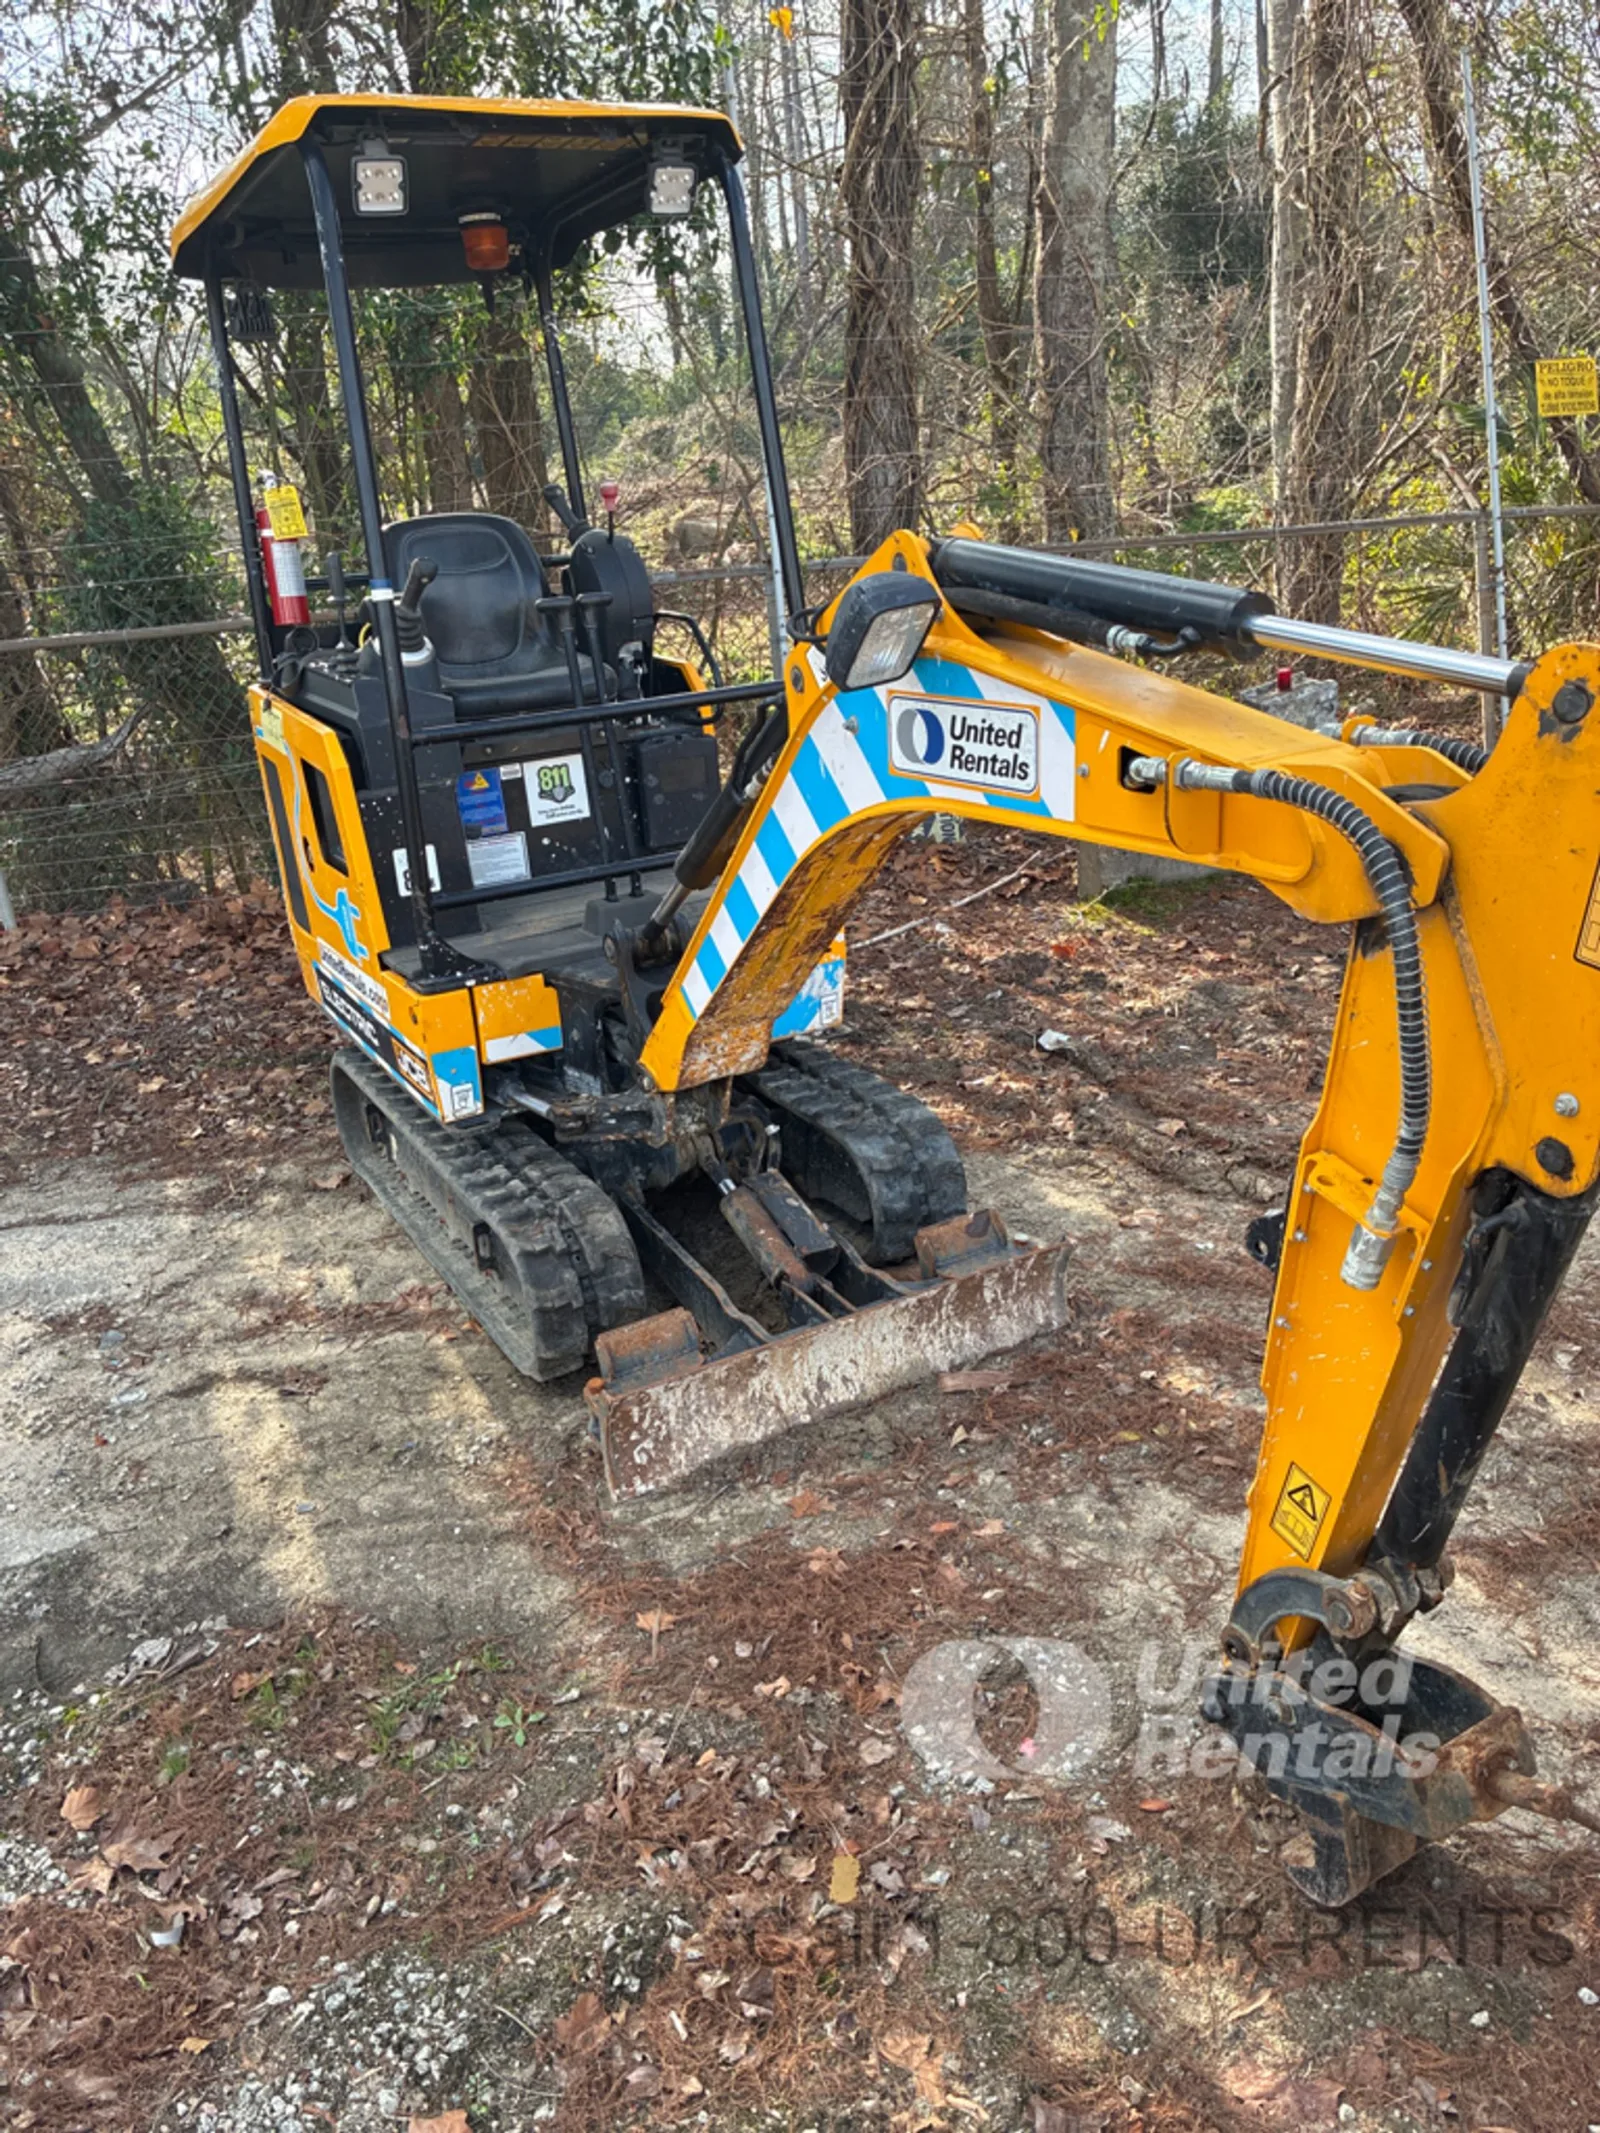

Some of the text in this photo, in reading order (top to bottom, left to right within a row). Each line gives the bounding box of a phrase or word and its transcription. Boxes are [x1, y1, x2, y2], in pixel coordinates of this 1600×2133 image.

[1540, 360, 1593, 374] PELIGRO
[1547, 376, 1559, 387] NO
[950, 715, 1023, 750] United
[950, 744, 1030, 781] Rentals
[538, 764, 571, 792] 811
